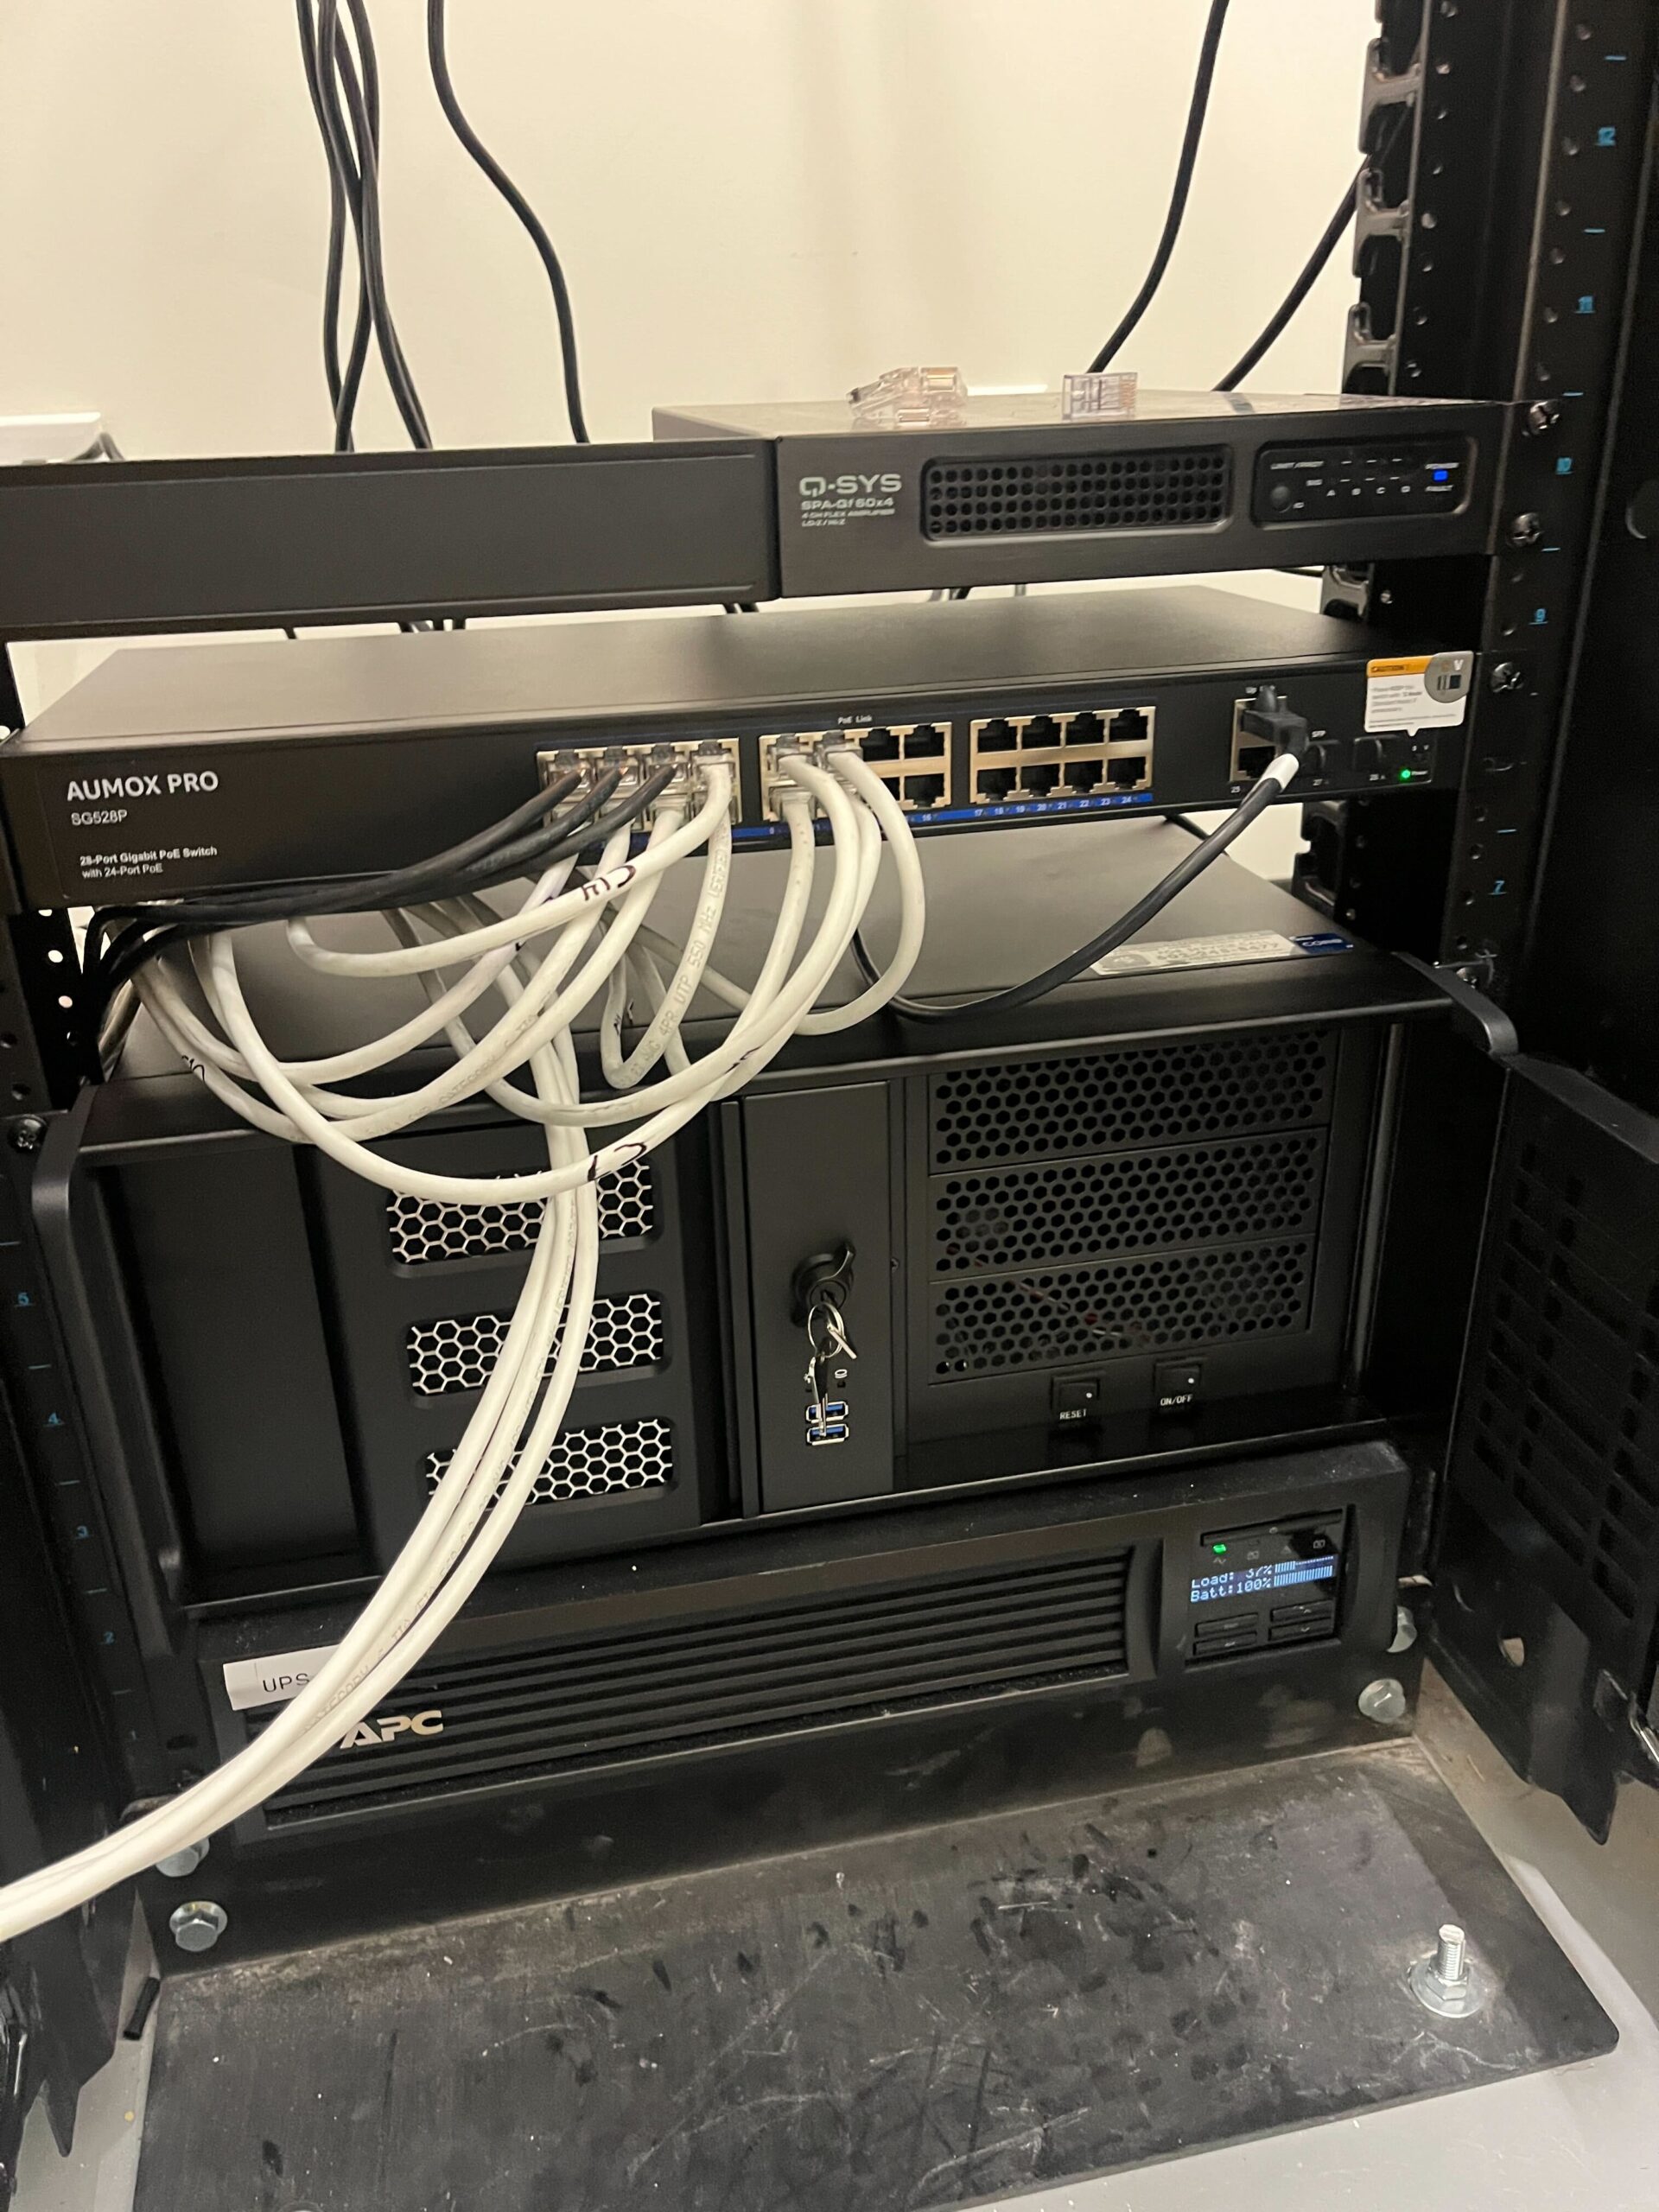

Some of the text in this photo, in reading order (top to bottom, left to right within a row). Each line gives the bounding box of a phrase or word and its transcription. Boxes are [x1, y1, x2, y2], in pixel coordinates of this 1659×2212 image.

[799, 474, 902, 497] Q-SYS
[67, 770, 219, 802] AUMOX PRO
[71, 809, 128, 826] SG528P
[159, 849, 181, 860] PoE
[182, 845, 219, 860] Switch
[82, 862, 164, 880] with 24-Port PoE
[696, 903, 718, 934] MHz
[685, 938, 708, 969] 550
[671, 973, 696, 1006] UTP
[1160, 1394, 1193, 1407] ON/OFF
[1059, 1408, 1088, 1420] RESET
[1192, 1571, 1235, 1589] Load:
[263, 1673, 310, 1693] UPS
[340, 1709, 444, 1750] APC
